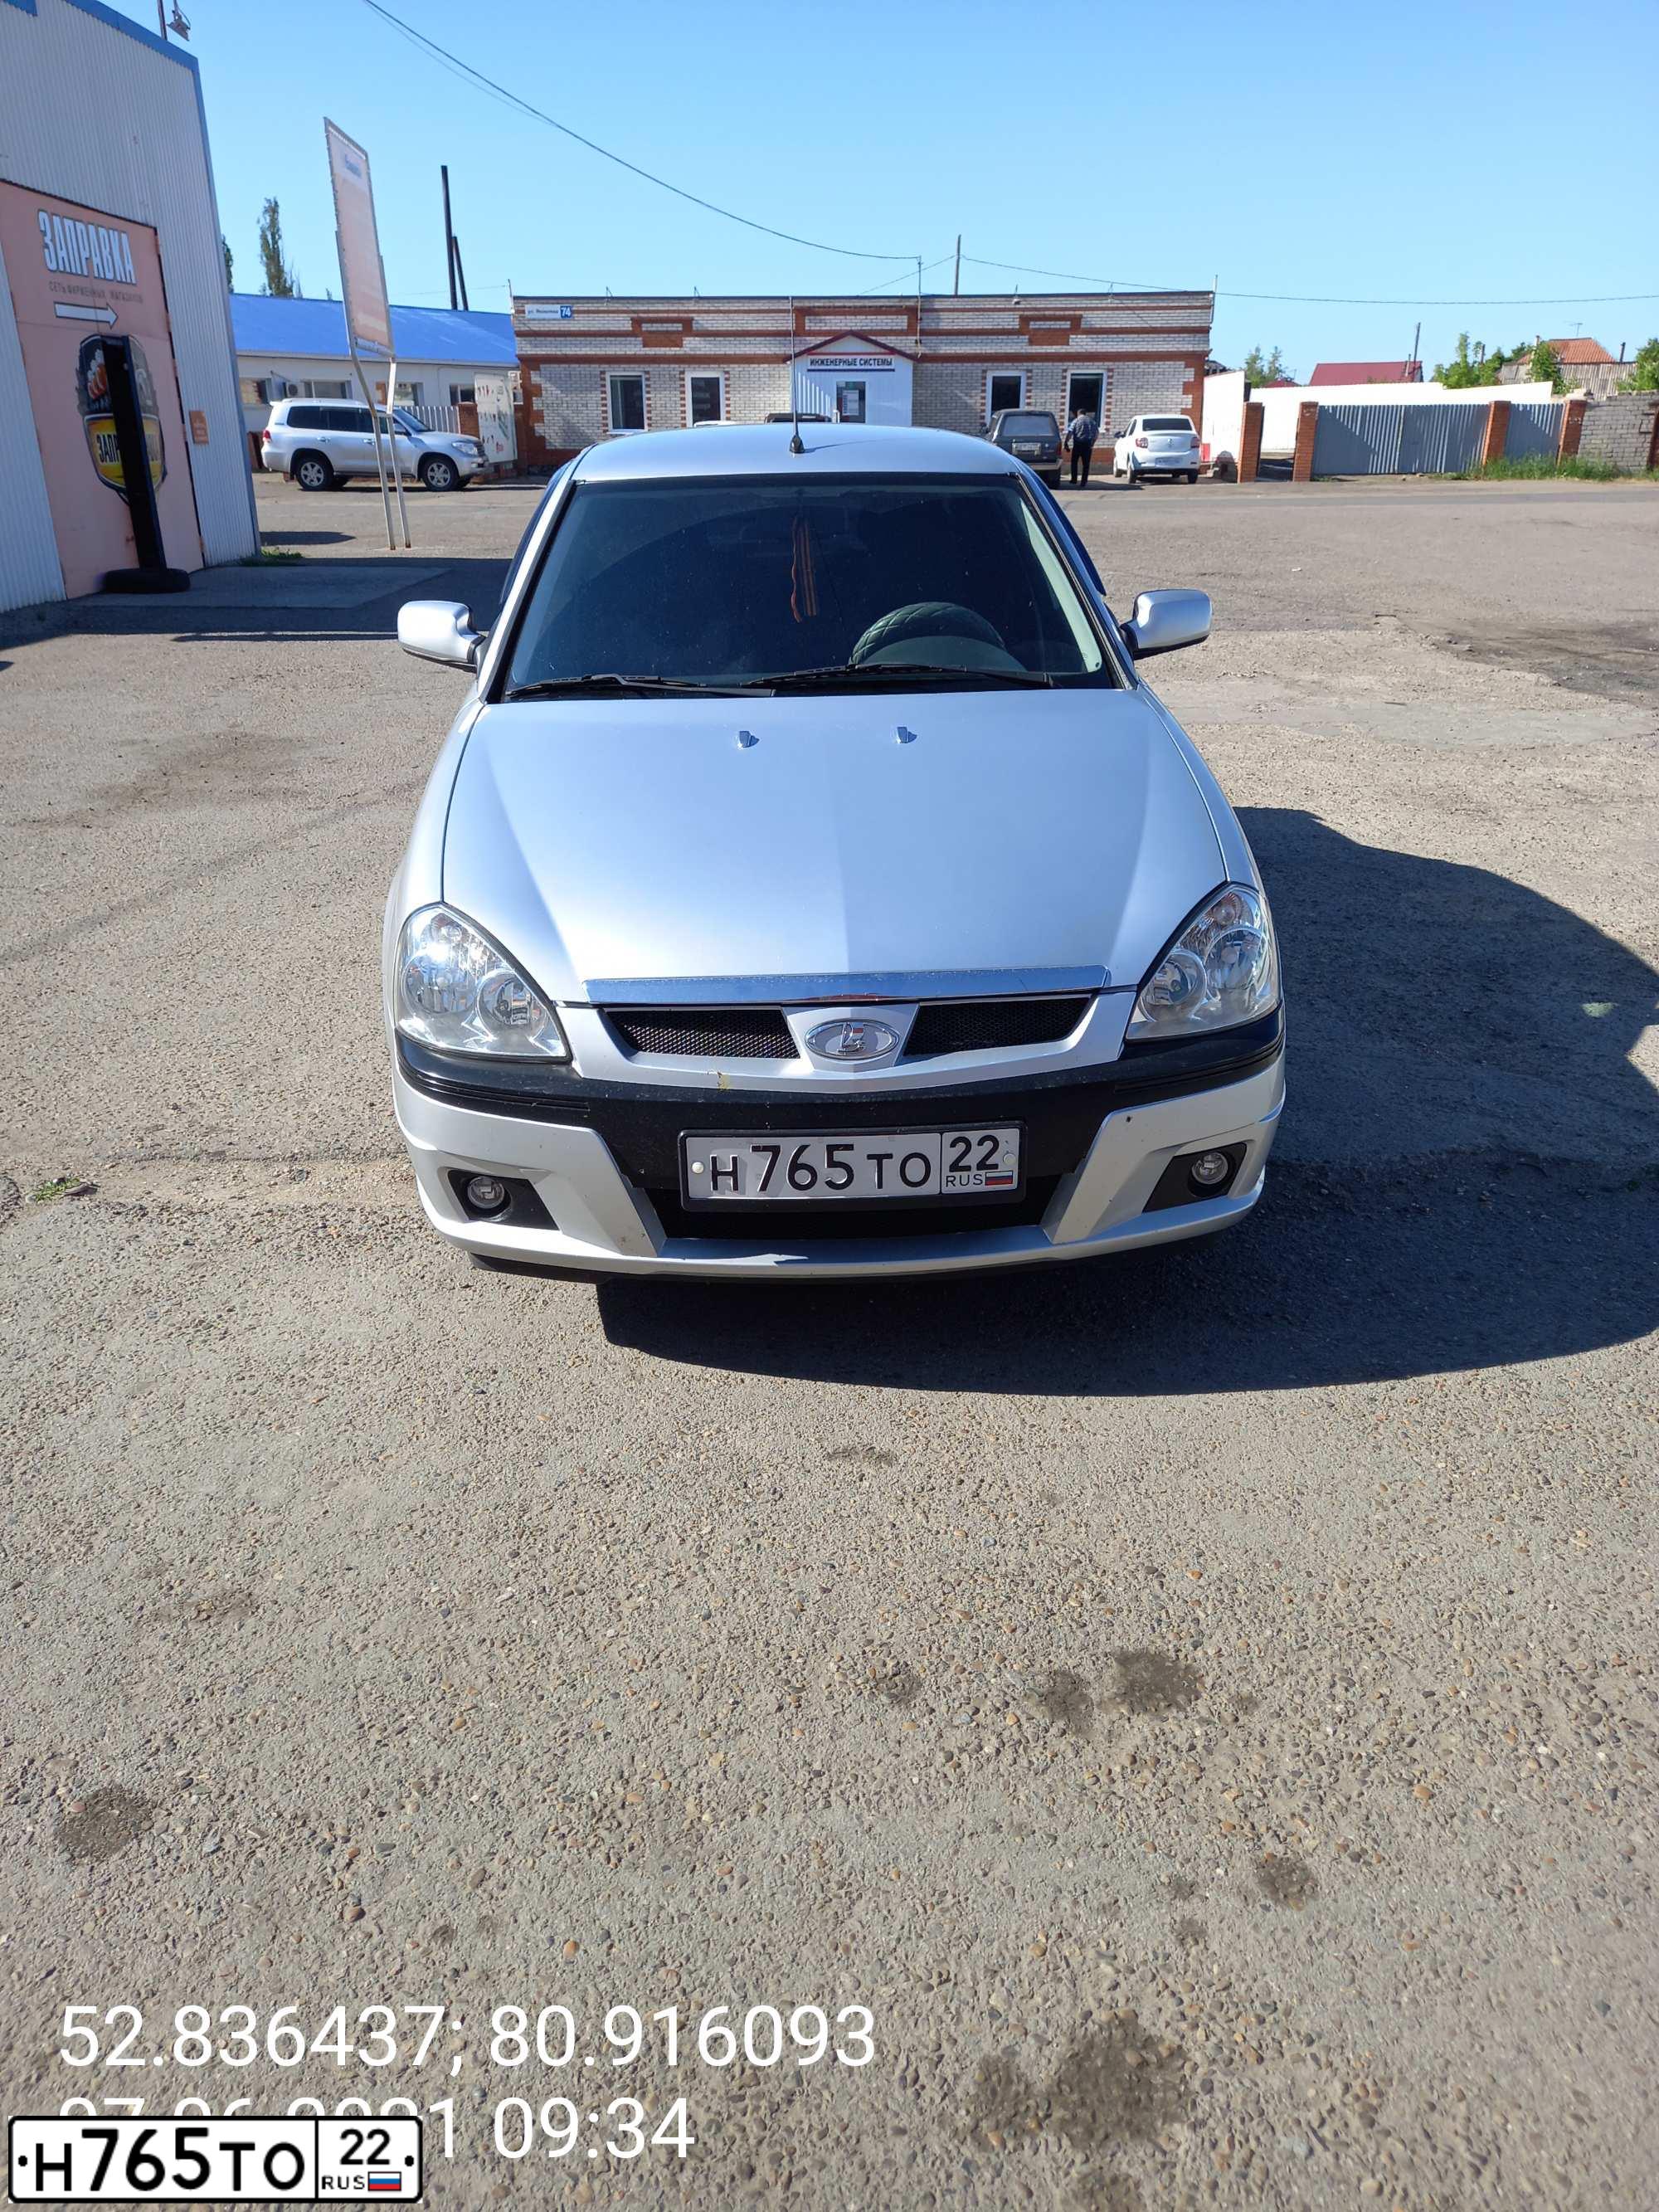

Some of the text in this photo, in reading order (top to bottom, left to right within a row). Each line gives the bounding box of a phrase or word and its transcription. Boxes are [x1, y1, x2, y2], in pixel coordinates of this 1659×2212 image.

[37, 208, 137, 285] ЗАПРАВКА
[561, 306, 572, 317] 74
[810, 358, 893, 367] ИНЖЕНЕРНЫЕ СИСТЕМЫ
[949, 1134, 1000, 1173] 22
[945, 1173, 984, 1188] RUS
